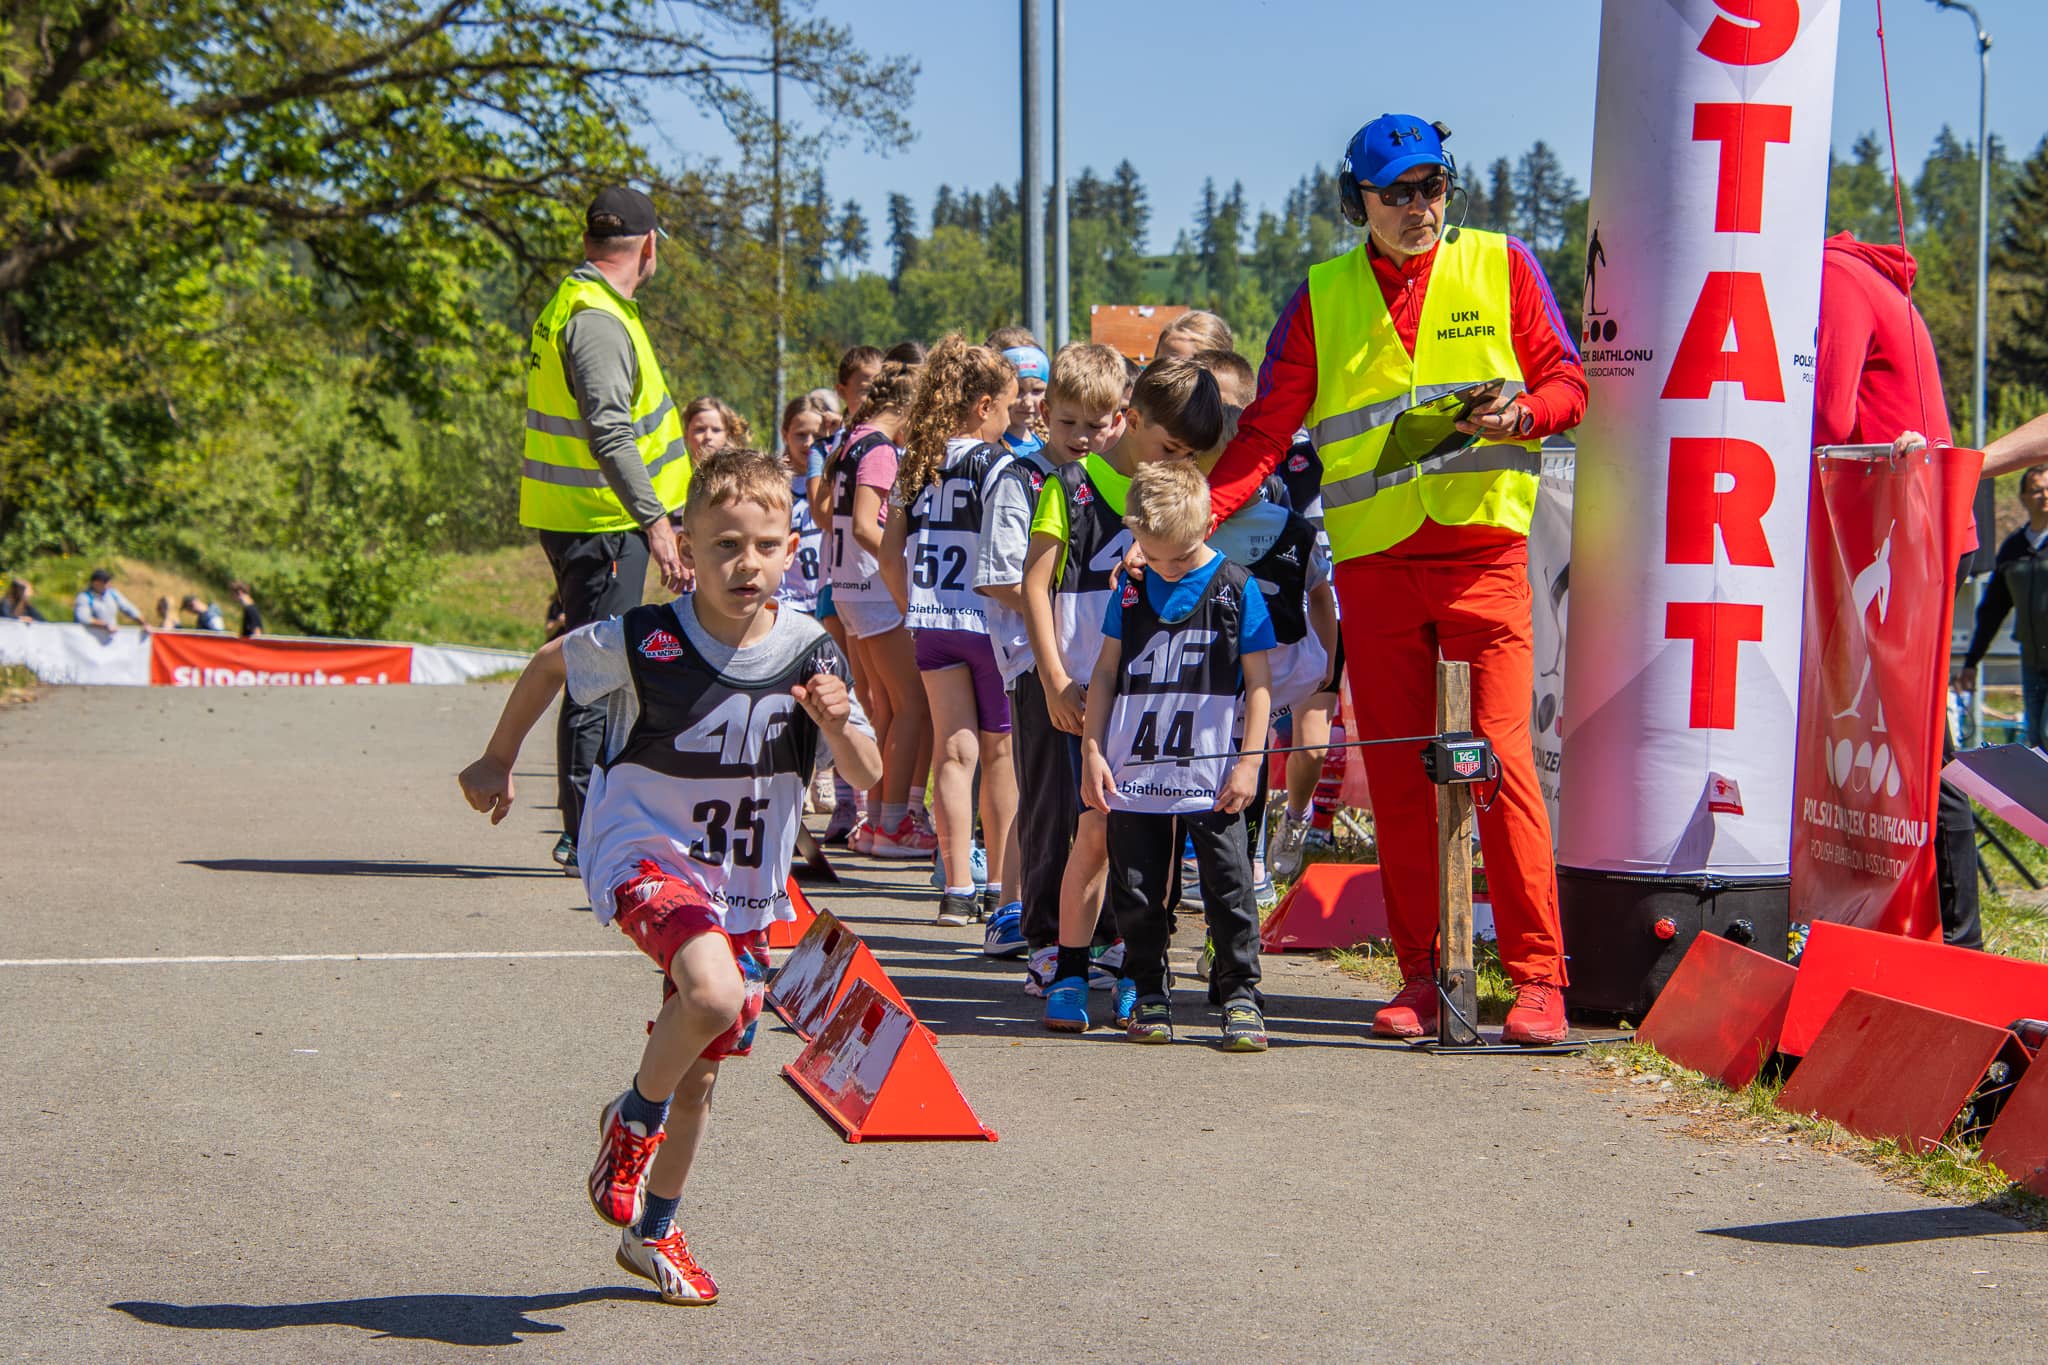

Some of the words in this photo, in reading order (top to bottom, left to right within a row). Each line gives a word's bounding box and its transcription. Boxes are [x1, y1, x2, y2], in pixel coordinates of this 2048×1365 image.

[1436, 324, 1496, 341] MELAFIR
[1450, 310, 1480, 324] UKN
[1587, 367, 1635, 377] ASSOCIATION
[1591, 349, 1654, 362] BIATHLONU
[1660, 0, 1800, 730] START
[833, 527, 844, 568] 1
[912, 542, 967, 592] 52
[1128, 629, 1219, 684] 4F
[673, 692, 796, 765] 4F
[1130, 710, 1195, 768] 44
[1455, 761, 1480, 776] HEUER
[1457, 751, 1476, 762] TAG
[689, 796, 770, 869] 35
[1868, 812, 1929, 848] BIATHLONU
